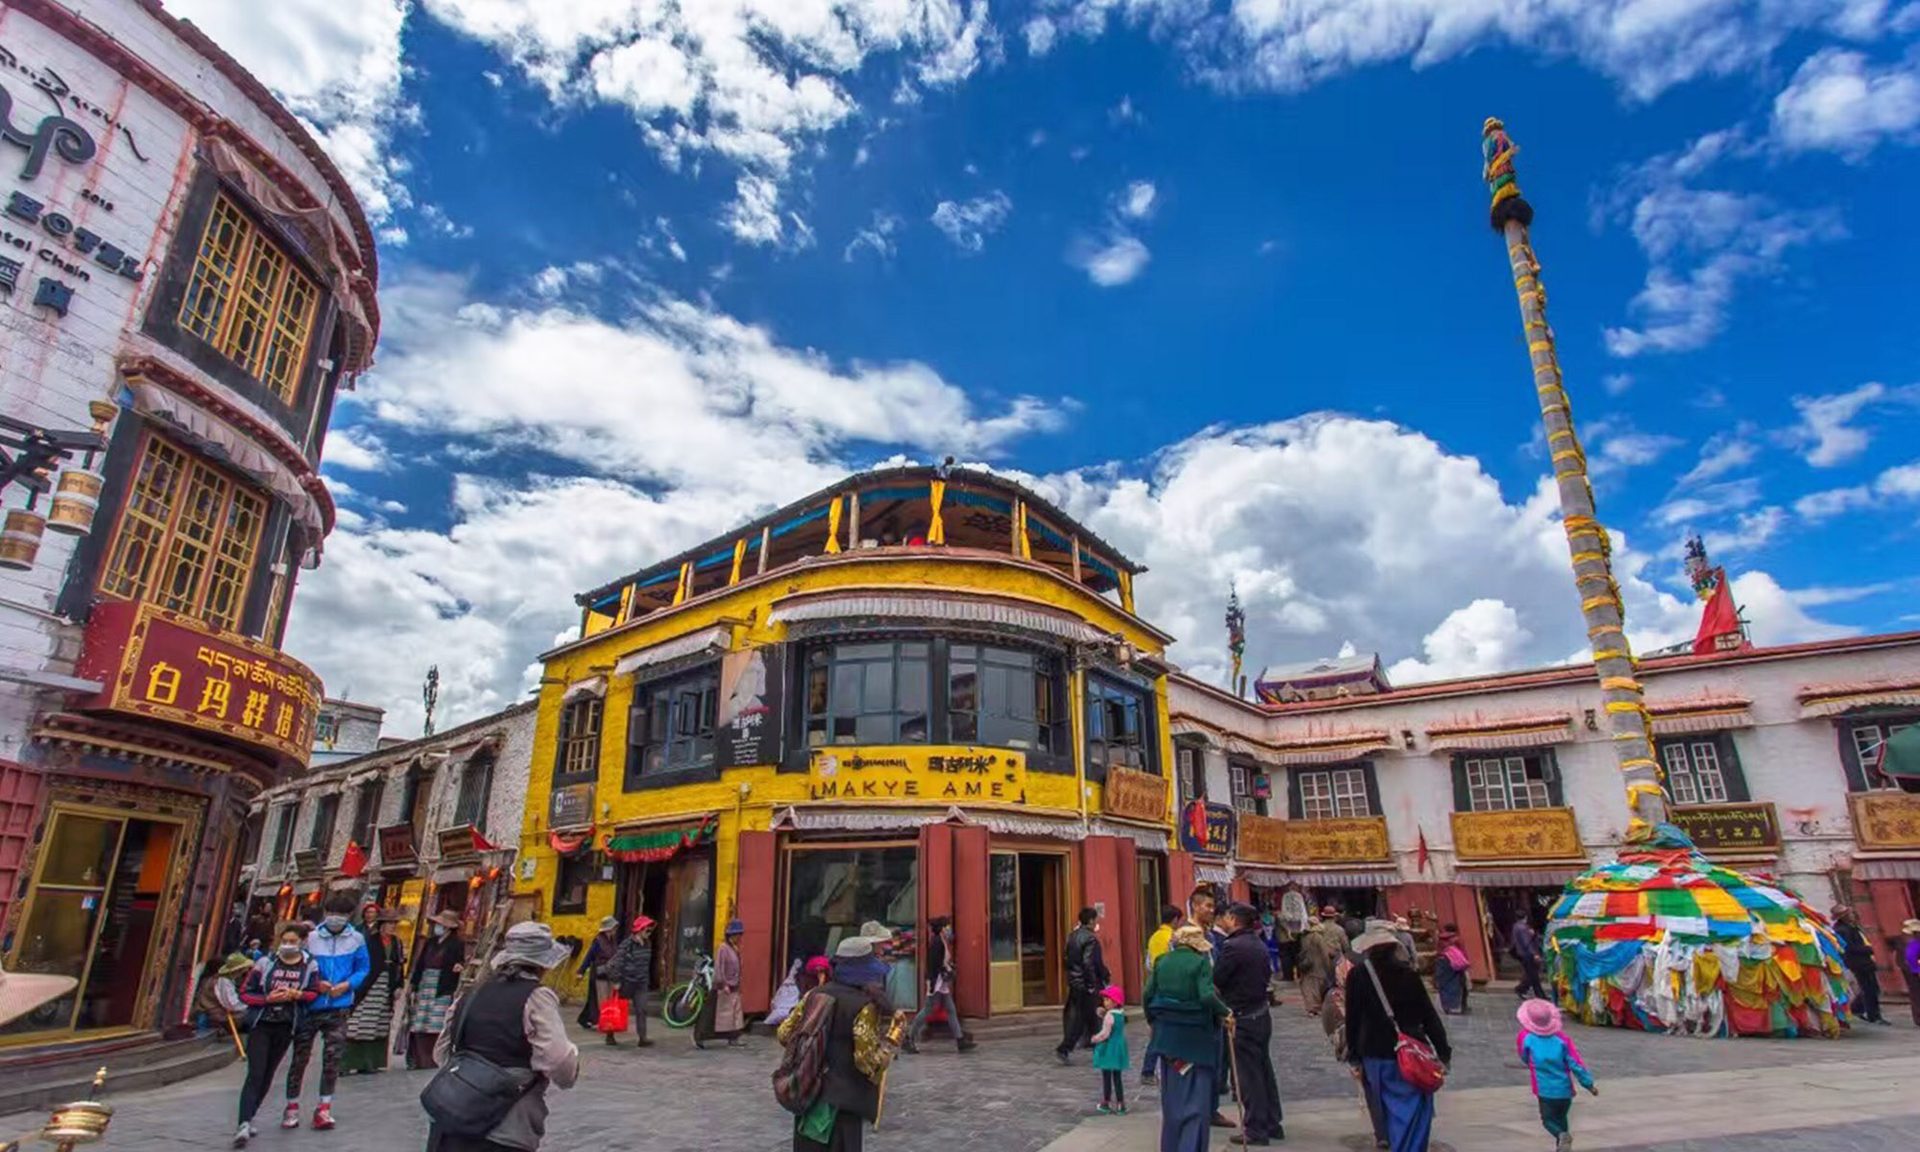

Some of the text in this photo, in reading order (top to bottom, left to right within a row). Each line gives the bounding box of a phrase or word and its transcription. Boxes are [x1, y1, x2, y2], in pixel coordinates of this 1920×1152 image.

[5, 190, 145, 283] HOTEL
[0, 229, 91, 282] tel Chain
[821, 780, 1004, 797] MAKYE AME
[1684, 825, 1763, 841] 工艺品店
